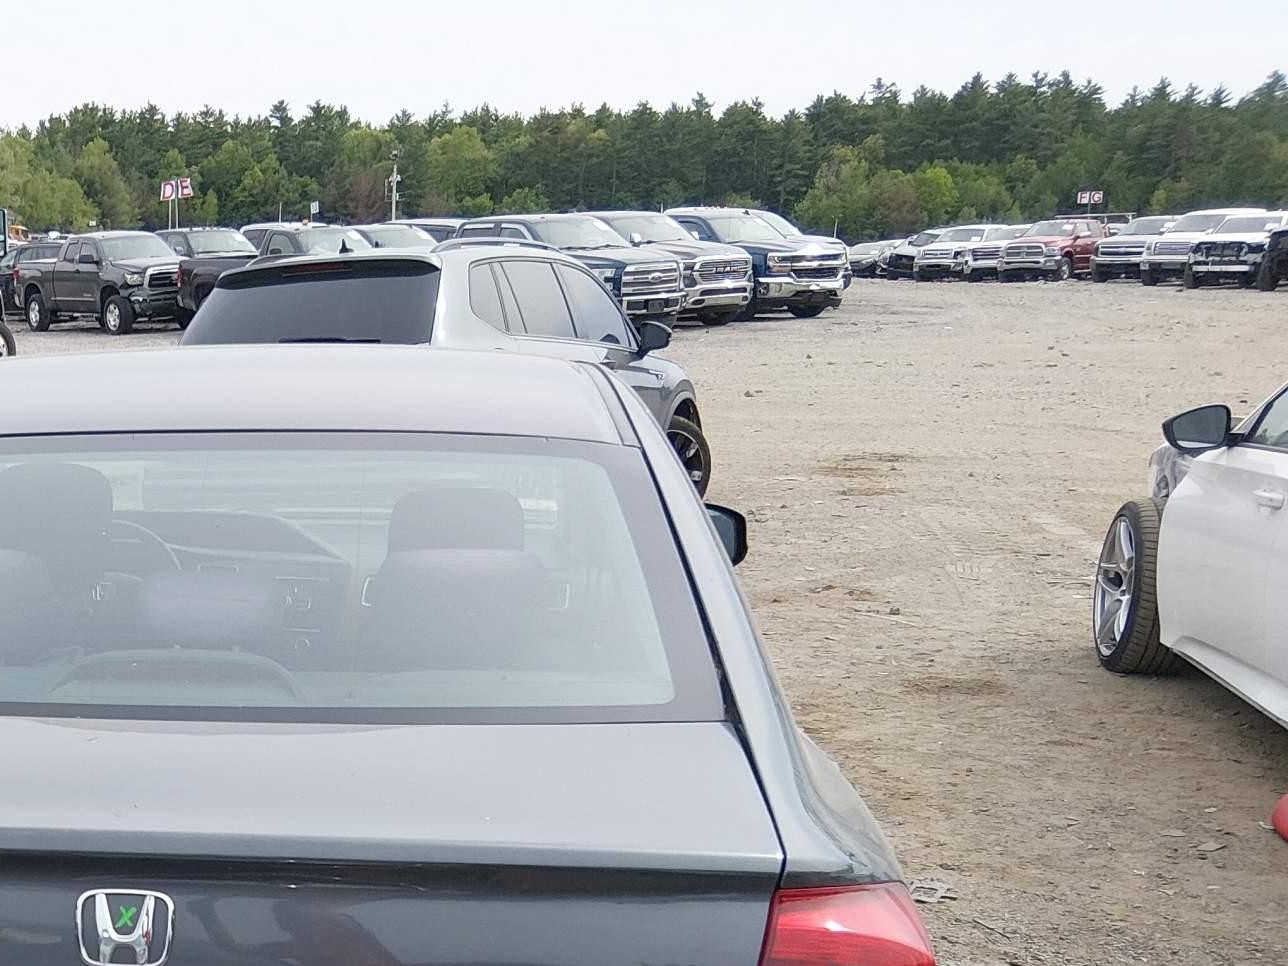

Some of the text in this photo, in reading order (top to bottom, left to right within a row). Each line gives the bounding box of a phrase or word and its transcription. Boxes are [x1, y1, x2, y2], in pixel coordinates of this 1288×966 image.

[163, 179, 192, 200] D E
[1092, 192, 1102, 203] G
